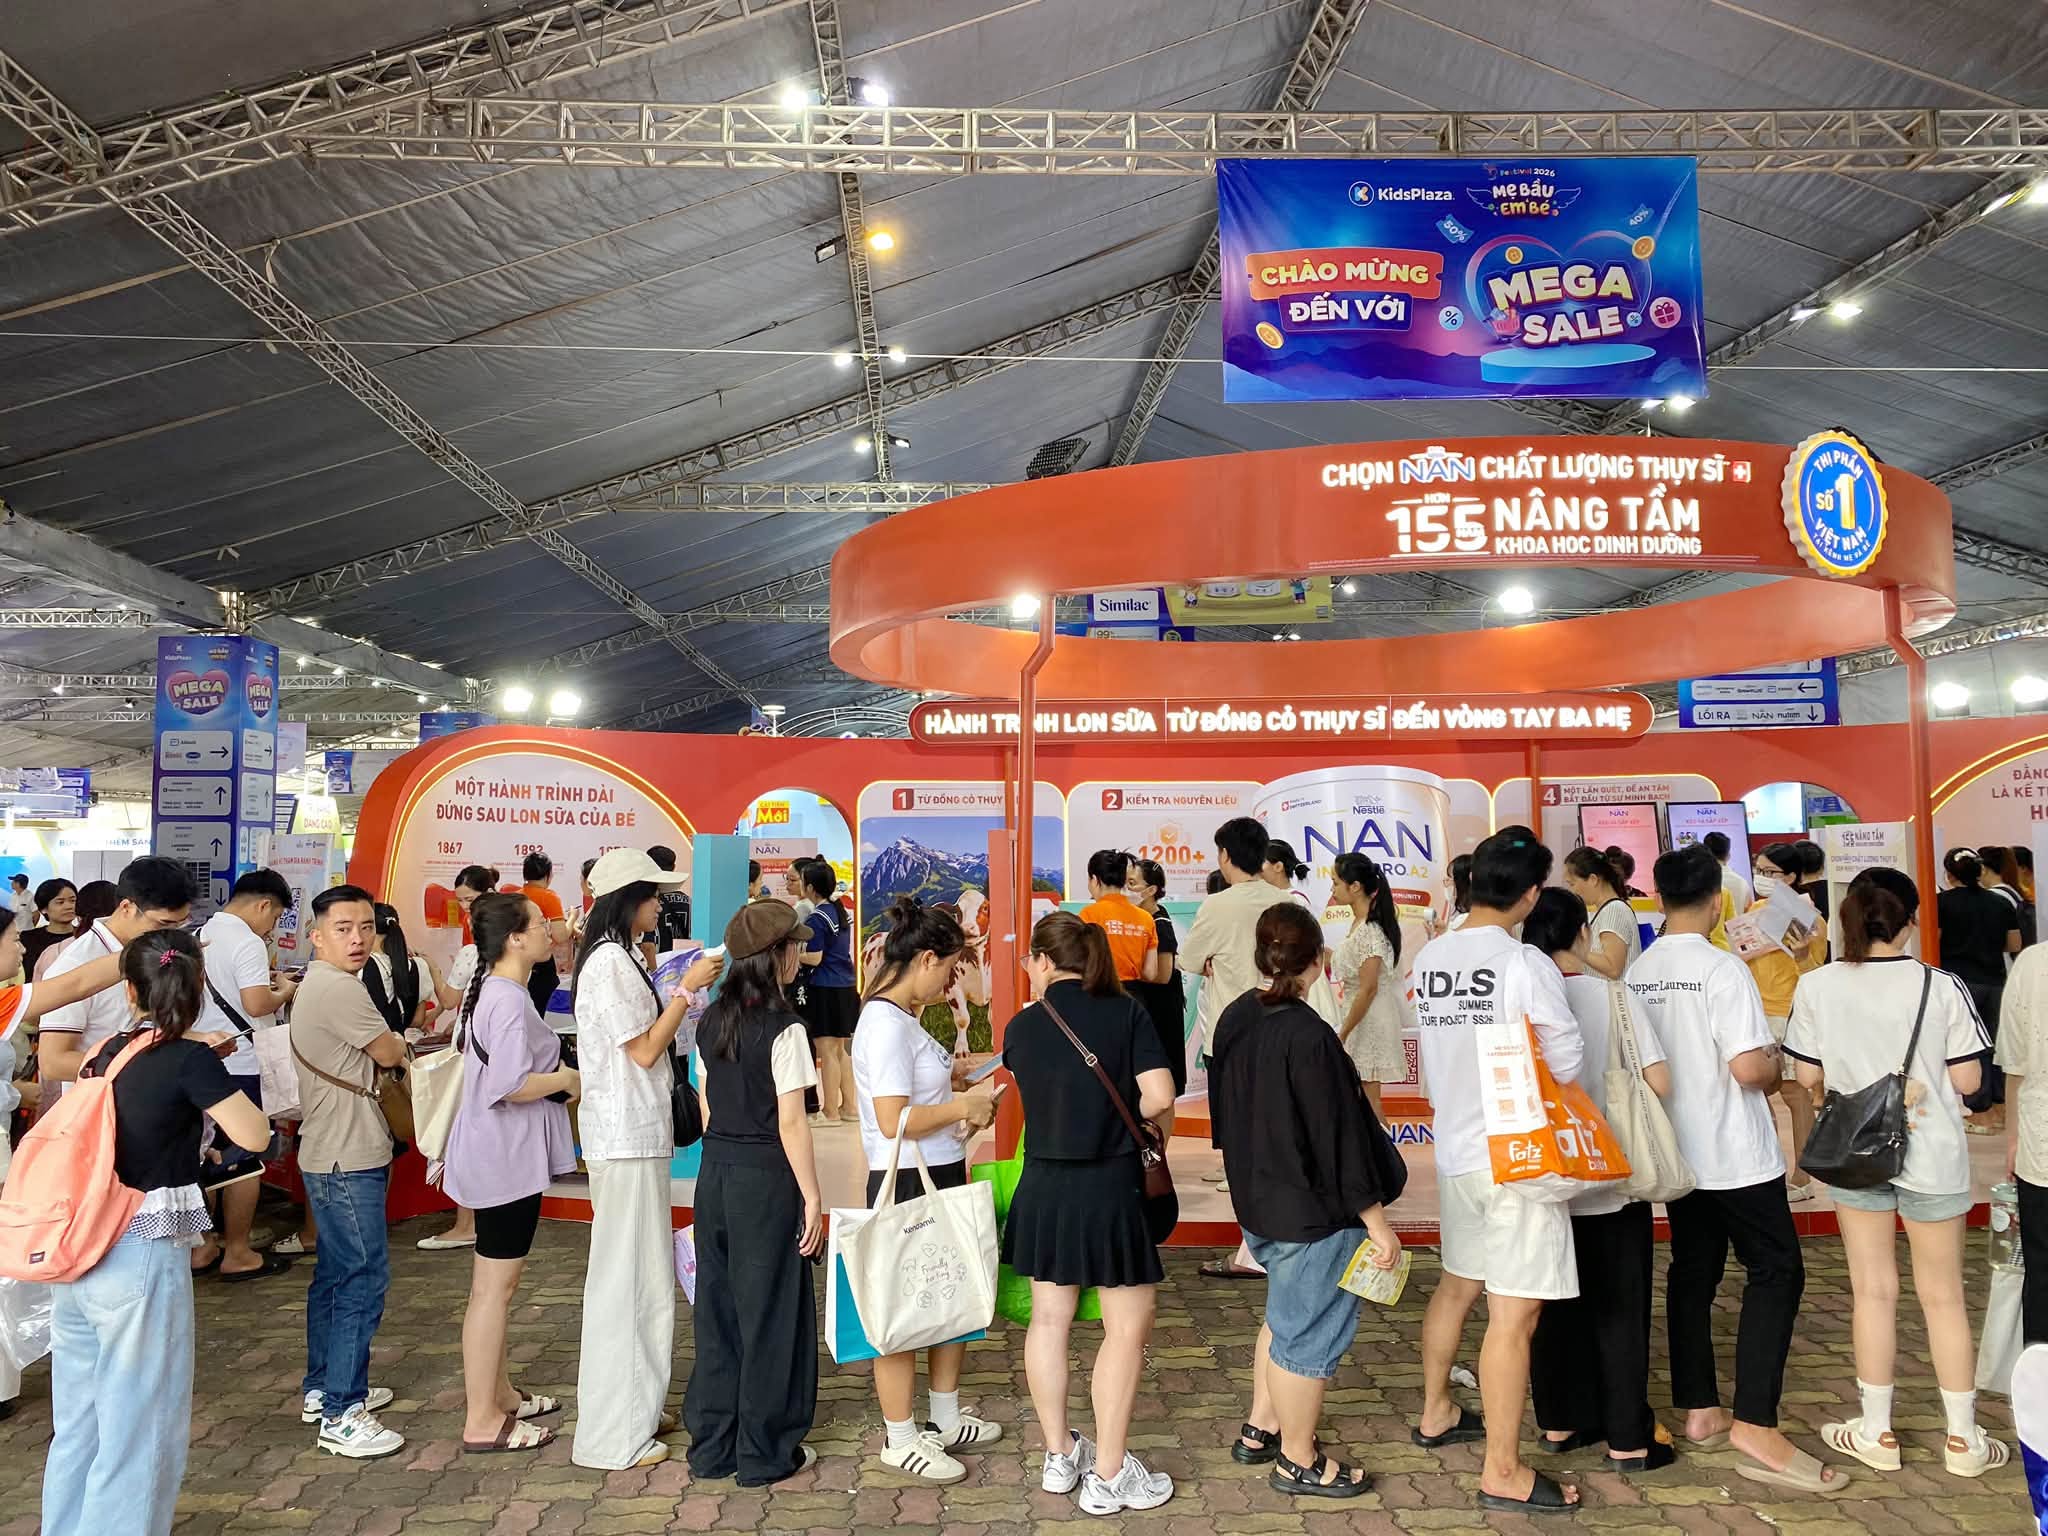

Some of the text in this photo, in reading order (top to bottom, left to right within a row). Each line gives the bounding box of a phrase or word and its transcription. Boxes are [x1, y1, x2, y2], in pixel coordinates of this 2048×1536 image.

[1533, 167, 1556, 177] 2026
[1378, 187, 1453, 201] KidsPlaza
[1492, 183, 1517, 199] Mẹ
[1443, 220, 1468, 240] 50%
[1260, 256, 1430, 286] CHÀO MỪNG
[1488, 265, 1633, 309] MEGA
[1289, 292, 1405, 321] ĐẾN VỚI
[1522, 308, 1625, 346] SALE
[1322, 460, 1394, 491] CHỌN
[1480, 447, 1547, 479] CHẤT
[1551, 453, 1634, 485] LƯỢNG
[1637, 457, 1699, 486] THỤY
[1814, 452, 1833, 473] THỊ
[1494, 482, 1701, 532] NÂNG TẦM
[1815, 473, 1856, 530] SỐ 1
[1385, 504, 1488, 553] 155
[1814, 517, 1867, 551] VIỆT NAM
[1496, 536, 1549, 555] KHOA
[1595, 536, 1638, 554] DINH
[1100, 598, 1150, 612] Similac
[173, 680, 225, 698] MEGA
[249, 684, 272, 699] MEGA
[183, 695, 218, 709] SALE
[253, 700, 269, 711] SALE
[925, 708, 1157, 734] HÀNH TRNH LON SỮA
[1167, 704, 1386, 735] TỪ ĐỒNG CỎ THỤY SĨ
[1393, 701, 1632, 731] ĐẾN VÒNG TAY BA MẸ
[1716, 711, 1731, 720] RA
[455, 776, 614, 803] MỘT HÀNH TRÌNH DÀI
[1544, 787, 1557, 804] 4
[1992, 781, 2048, 798] LÀ KẾ T
[898, 792, 907, 809] 1
[918, 795, 933, 805] TỪ
[933, 792, 960, 805] ĐỒNG
[1106, 793, 1237, 809] 2 KIỂM TRA NGUYÊN LIỆU
[437, 800, 636, 827] ĐỨNG SAU LON SỮA CỦA BÉ
[2031, 805, 2048, 820] H
[437, 842, 463, 855] 1867
[1304, 819, 1433, 862] NAN
[1138, 845, 1205, 865] 1200+
[1410, 866, 1429, 879] A2
[1416, 968, 1497, 1000] JDLS
[1659, 980, 1702, 992] Laurent
[1458, 1000, 1494, 1011] SUMMER
[1472, 1014, 1495, 1025] SS26
